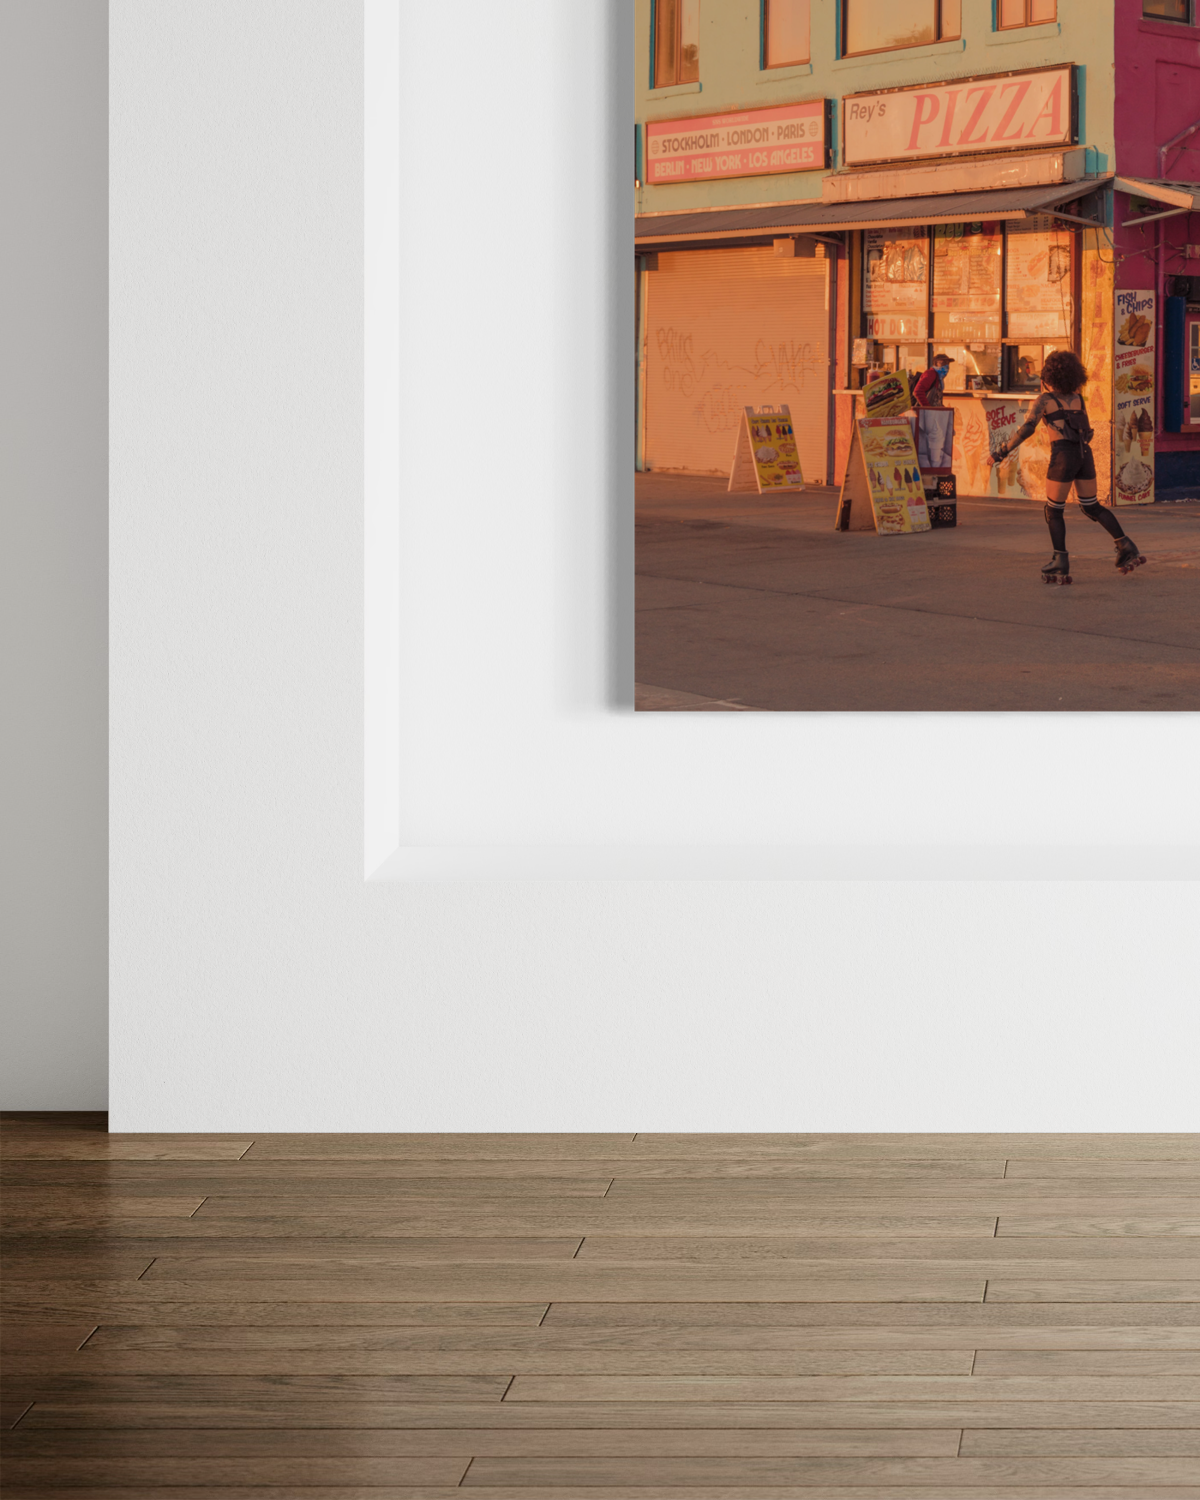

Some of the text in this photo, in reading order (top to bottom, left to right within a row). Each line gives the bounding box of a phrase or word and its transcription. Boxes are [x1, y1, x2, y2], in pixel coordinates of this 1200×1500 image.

[850, 101, 886, 122] Rey's
[904, 75, 1064, 151] PIZZA
[661, 123, 805, 154] STOCKHOLM LONDON PARIS
[654, 147, 814, 177] BERLIN NEW YORK LOS ANGELES
[1117, 291, 1137, 307] FISH
[1121, 298, 1153, 316] & CHIPS
[868, 318, 919, 336] HOT DOGS
[1090, 259, 1108, 413] PIZZA
[1115, 345, 1154, 362] CHEESEBURGER
[1121, 358, 1137, 368] FRIES
[1117, 396, 1151, 410] SOFT SERVE
[986, 405, 1006, 422] SOFT
[991, 412, 1017, 431] SERVE
[1118, 491, 1137, 502] FUNNEL
